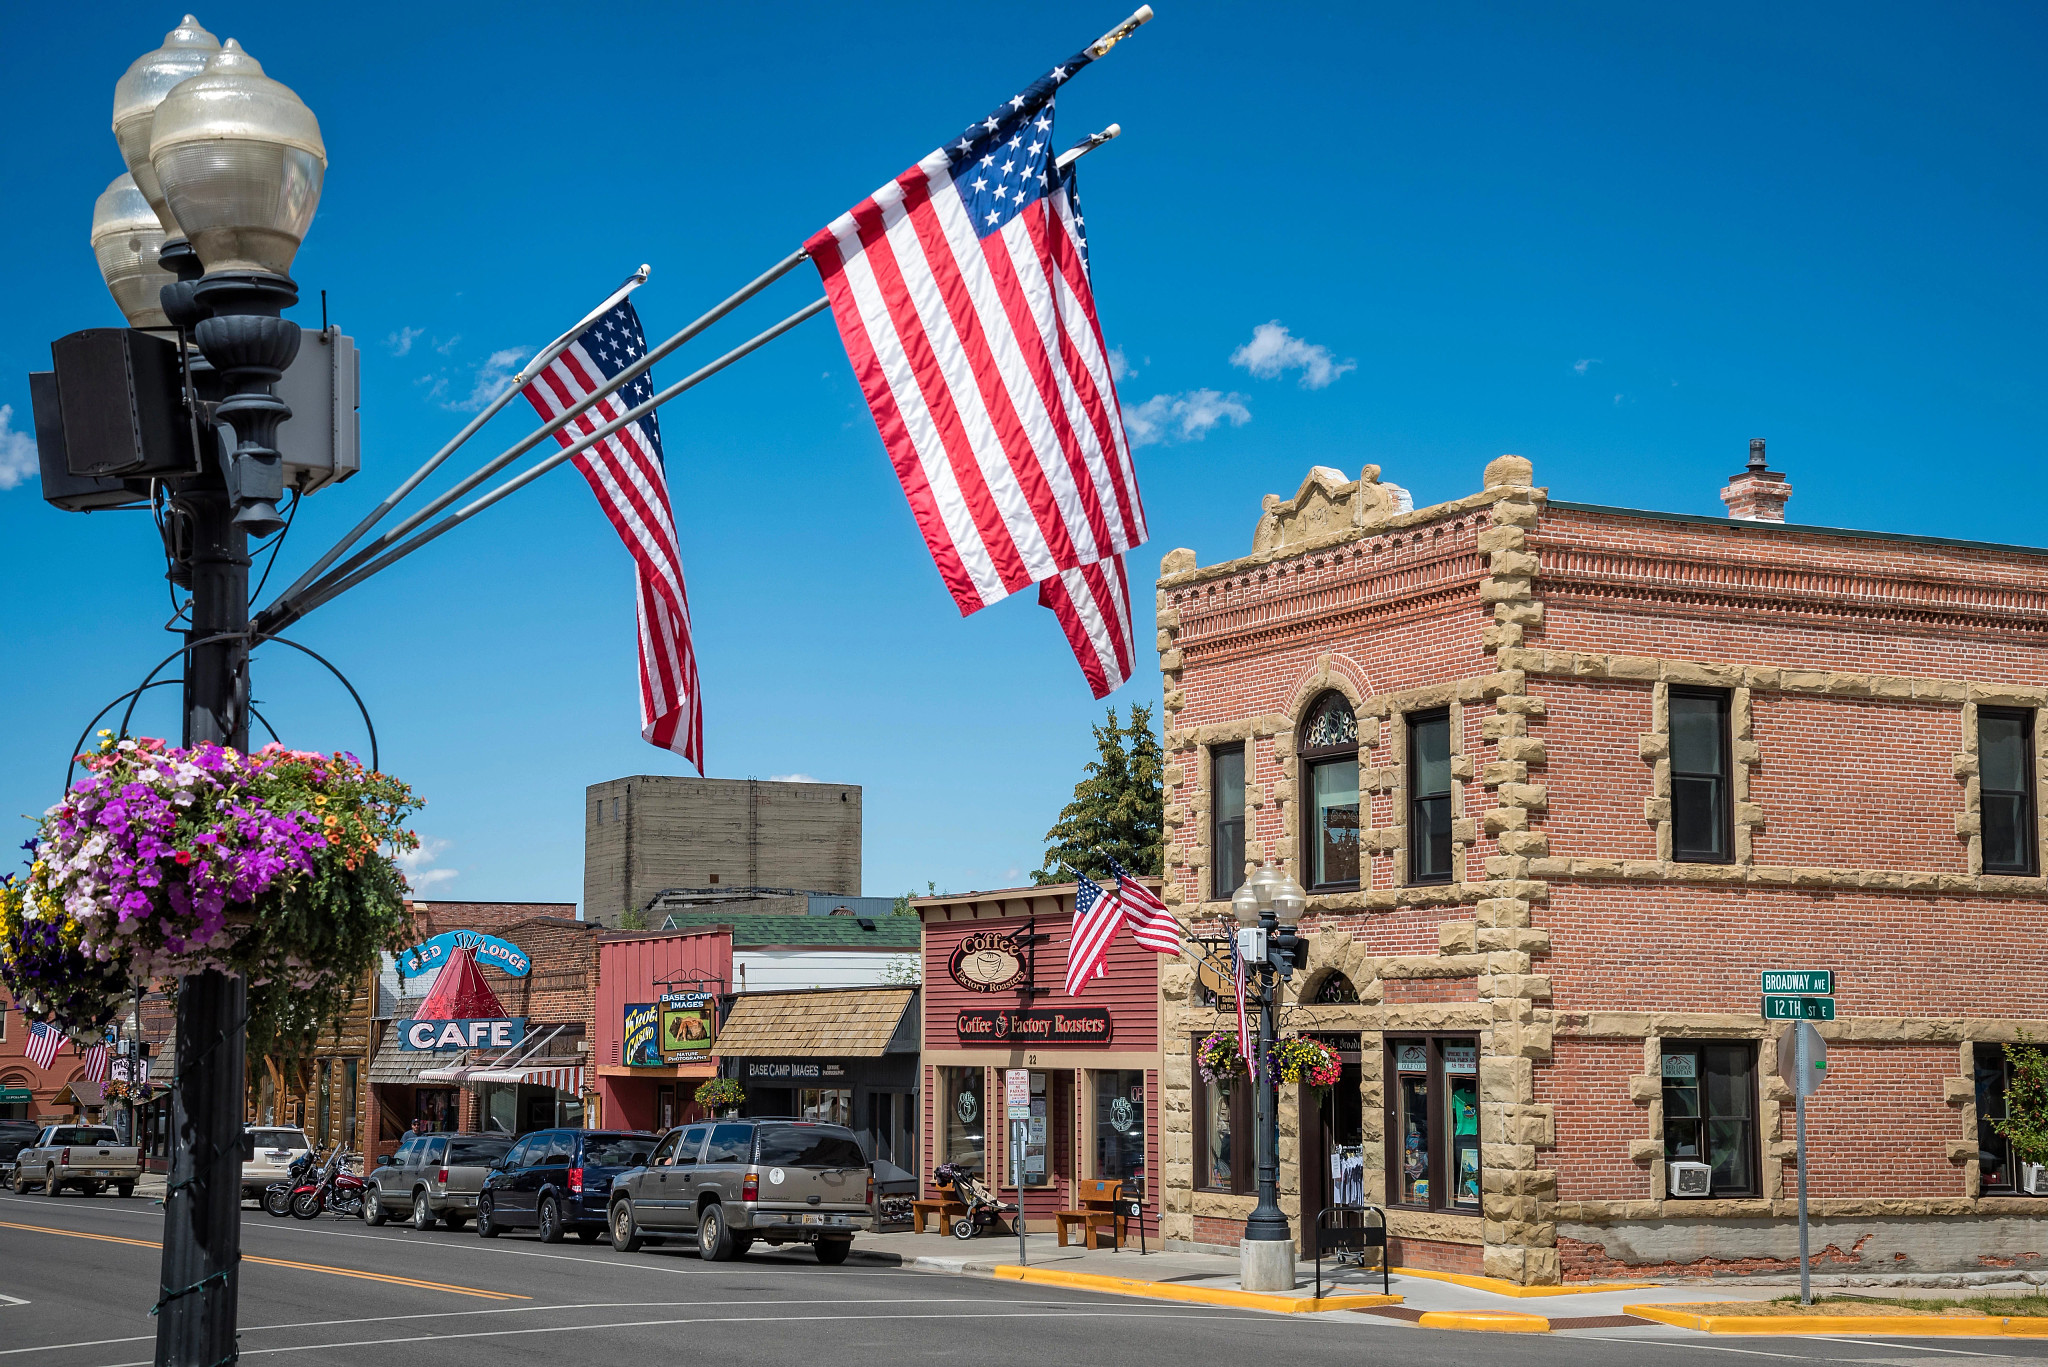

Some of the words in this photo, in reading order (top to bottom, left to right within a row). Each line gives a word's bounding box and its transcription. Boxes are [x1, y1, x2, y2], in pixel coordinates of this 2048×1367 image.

[962, 933, 1019, 956] Coffee
[408, 945, 442, 971] RED
[480, 942, 527, 971] LODGE
[956, 969, 987, 993] Factory
[989, 970, 1025, 992] Roasters
[1765, 974, 1810, 990] BROADWAY
[1814, 979, 1826, 990] AVE
[662, 994, 685, 1002] BASE
[687, 993, 713, 1001] CAMP
[671, 1001, 704, 1009] IMAGES
[1808, 1006, 1816, 1017] ST
[1821, 1006, 1827, 1017] E
[958, 1015, 993, 1033] Coffee
[1011, 1015, 1052, 1037] Factory
[1054, 1014, 1105, 1033] Roasters
[408, 1021, 513, 1049] CAFE
[1029, 1055, 1037, 1064] 22
[749, 1063, 768, 1076] BASE
[769, 1063, 790, 1077] CAMP
[791, 1063, 819, 1077] IMAGES
